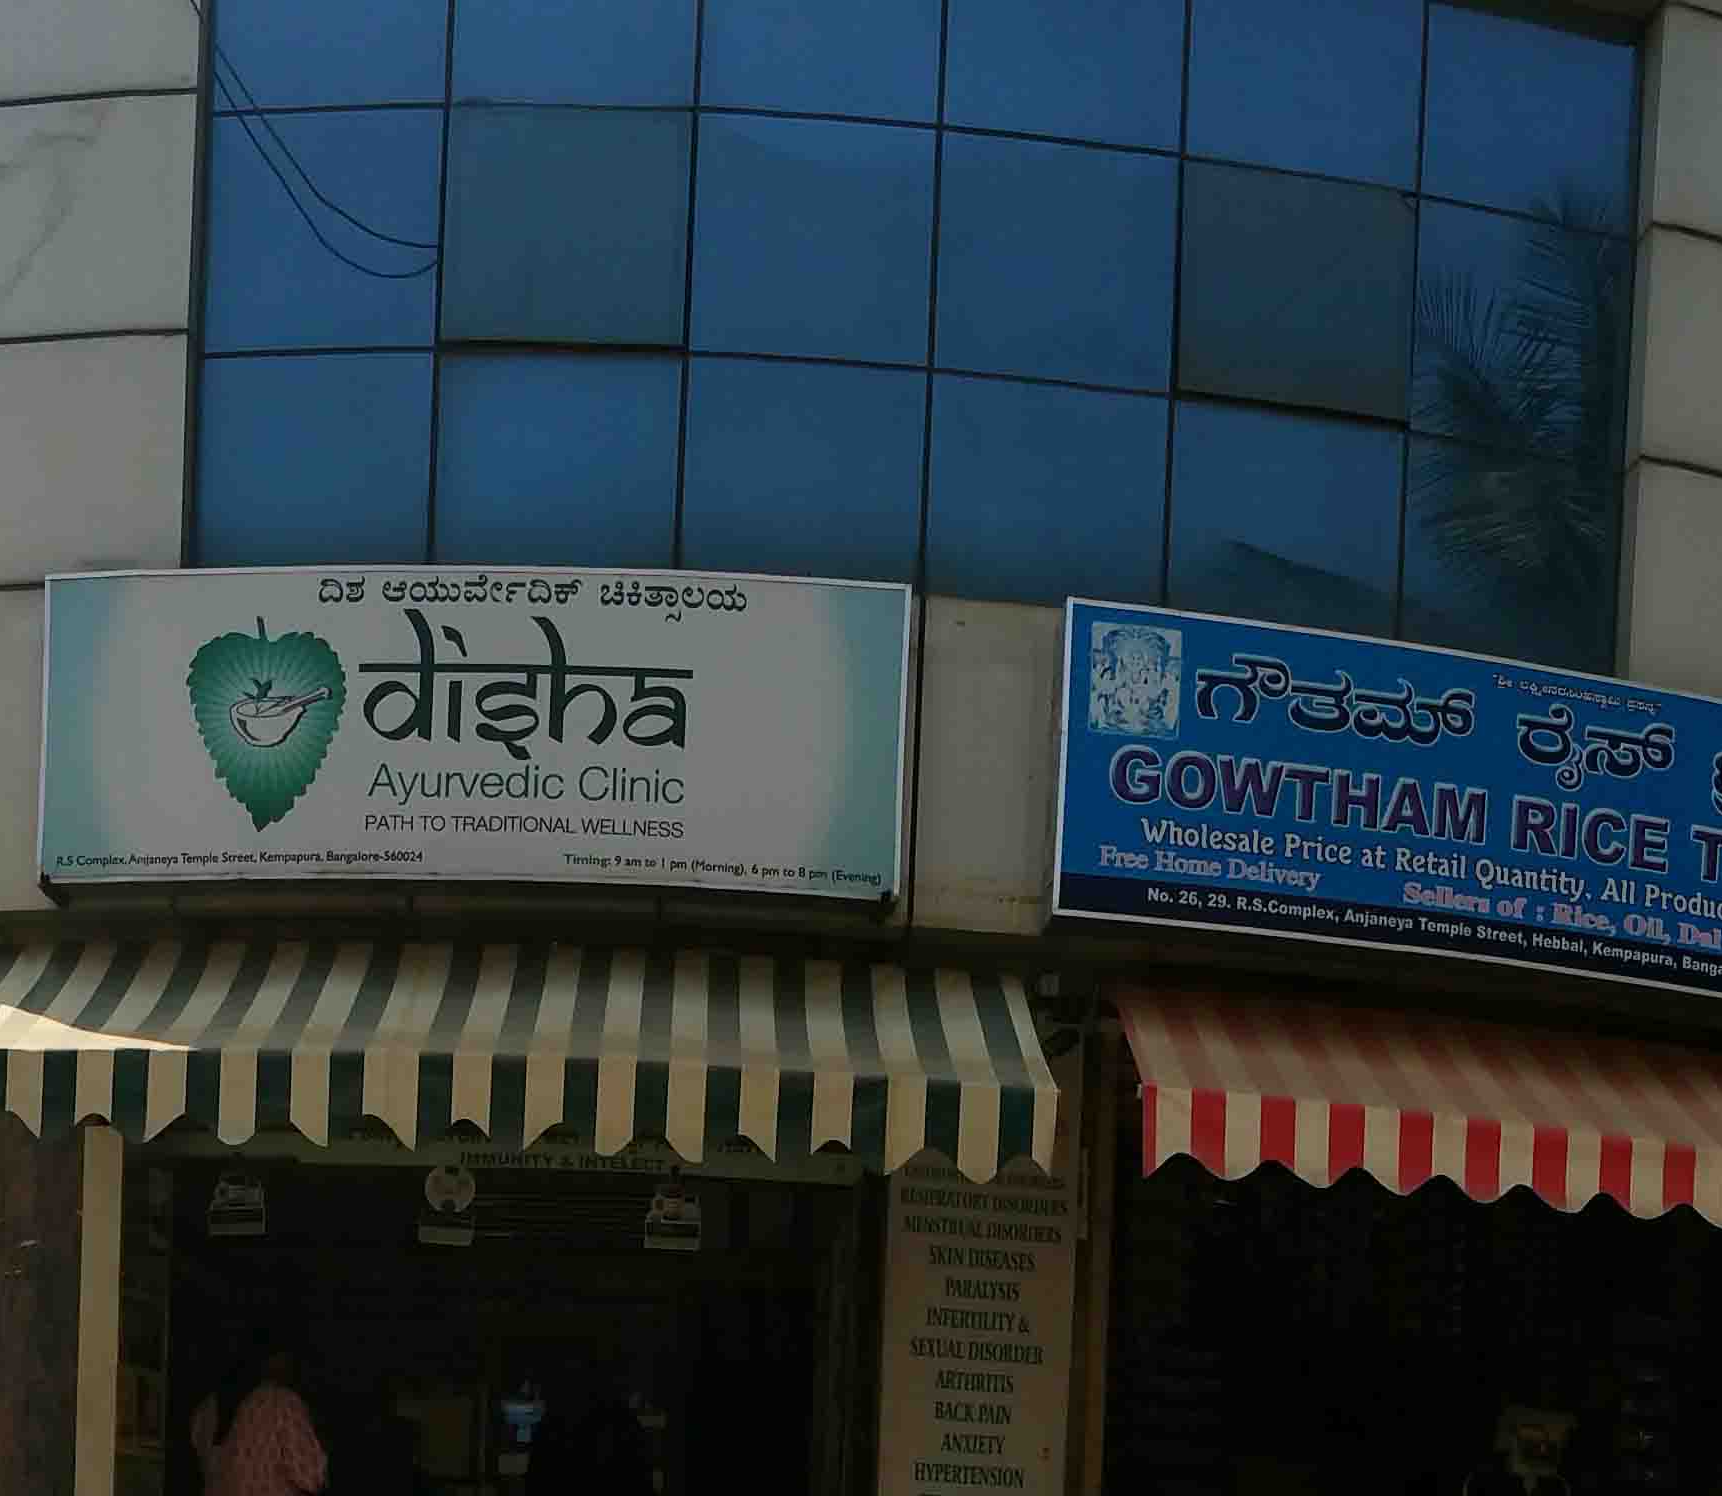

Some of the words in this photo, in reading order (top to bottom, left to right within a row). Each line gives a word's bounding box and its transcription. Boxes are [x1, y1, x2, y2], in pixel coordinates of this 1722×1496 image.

[318, 577, 365, 602] ದಿಶ
[359, 609, 693, 760] disha
[1195, 653, 1476, 746] ಗೌತಮ್
[1515, 704, 1676, 790] ರೈಸ್
[367, 763, 564, 806] Ayurvedic
[577, 765, 686, 805] Clinic
[1109, 744, 1488, 846] GOWTHAM
[1510, 793, 1670, 873] RICE
[364, 814, 417, 832] PATH
[422, 815, 447, 833] TO
[451, 815, 576, 835] TRADITIONAL
[580, 817, 684, 838] WELLNESS
[181, 853, 219, 866] Temple
[325, 851, 423, 864] Bangalore-560024
[564, 854, 611, 868] Timing:
[669, 860, 687, 872] pm
[831, 870, 882, 886] (Evening)
[1099, 845, 1149, 870] Free
[1153, 849, 1222, 879] Home
[1227, 857, 1321, 892] Delivery
[1140, 816, 1275, 857] Wholesale
[1283, 833, 1352, 864] Price
[1360, 846, 1387, 869] at
[1395, 846, 1467, 881] Retail
[1600, 877, 1636, 905] All
[1147, 887, 1174, 904] No.
[1178, 890, 1202, 909] 26,
[1237, 896, 1340, 923] R.S.Complex,
[1344, 908, 1414, 932] Anjaneya
[1418, 916, 1473, 938] Temple
[1476, 925, 1528, 949] Street,
[1532, 933, 1588, 959] Hebbal,
[1591, 942, 1678, 969] Kempapura,
[1404, 880, 1491, 915] Sellers
[1496, 895, 1528, 921] of
[1678, 922, 1722, 950] Dal
[928, 1246, 964, 1265] SKIN
[968, 1248, 1037, 1272] DISEASES
[944, 1276, 1020, 1302] PARALYSIS
[925, 1306, 1015, 1332] INFERTILITY
[910, 1336, 966, 1359] SEXUAL
[968, 1342, 1045, 1365] DISORDER
[935, 1370, 1014, 1394] ARTHRITIS
[934, 1402, 974, 1423] BACK
[978, 1406, 1011, 1425] PAIN
[941, 1432, 1006, 1455] ANXIETY
[914, 1462, 1024, 1488] HYPERTENSION
